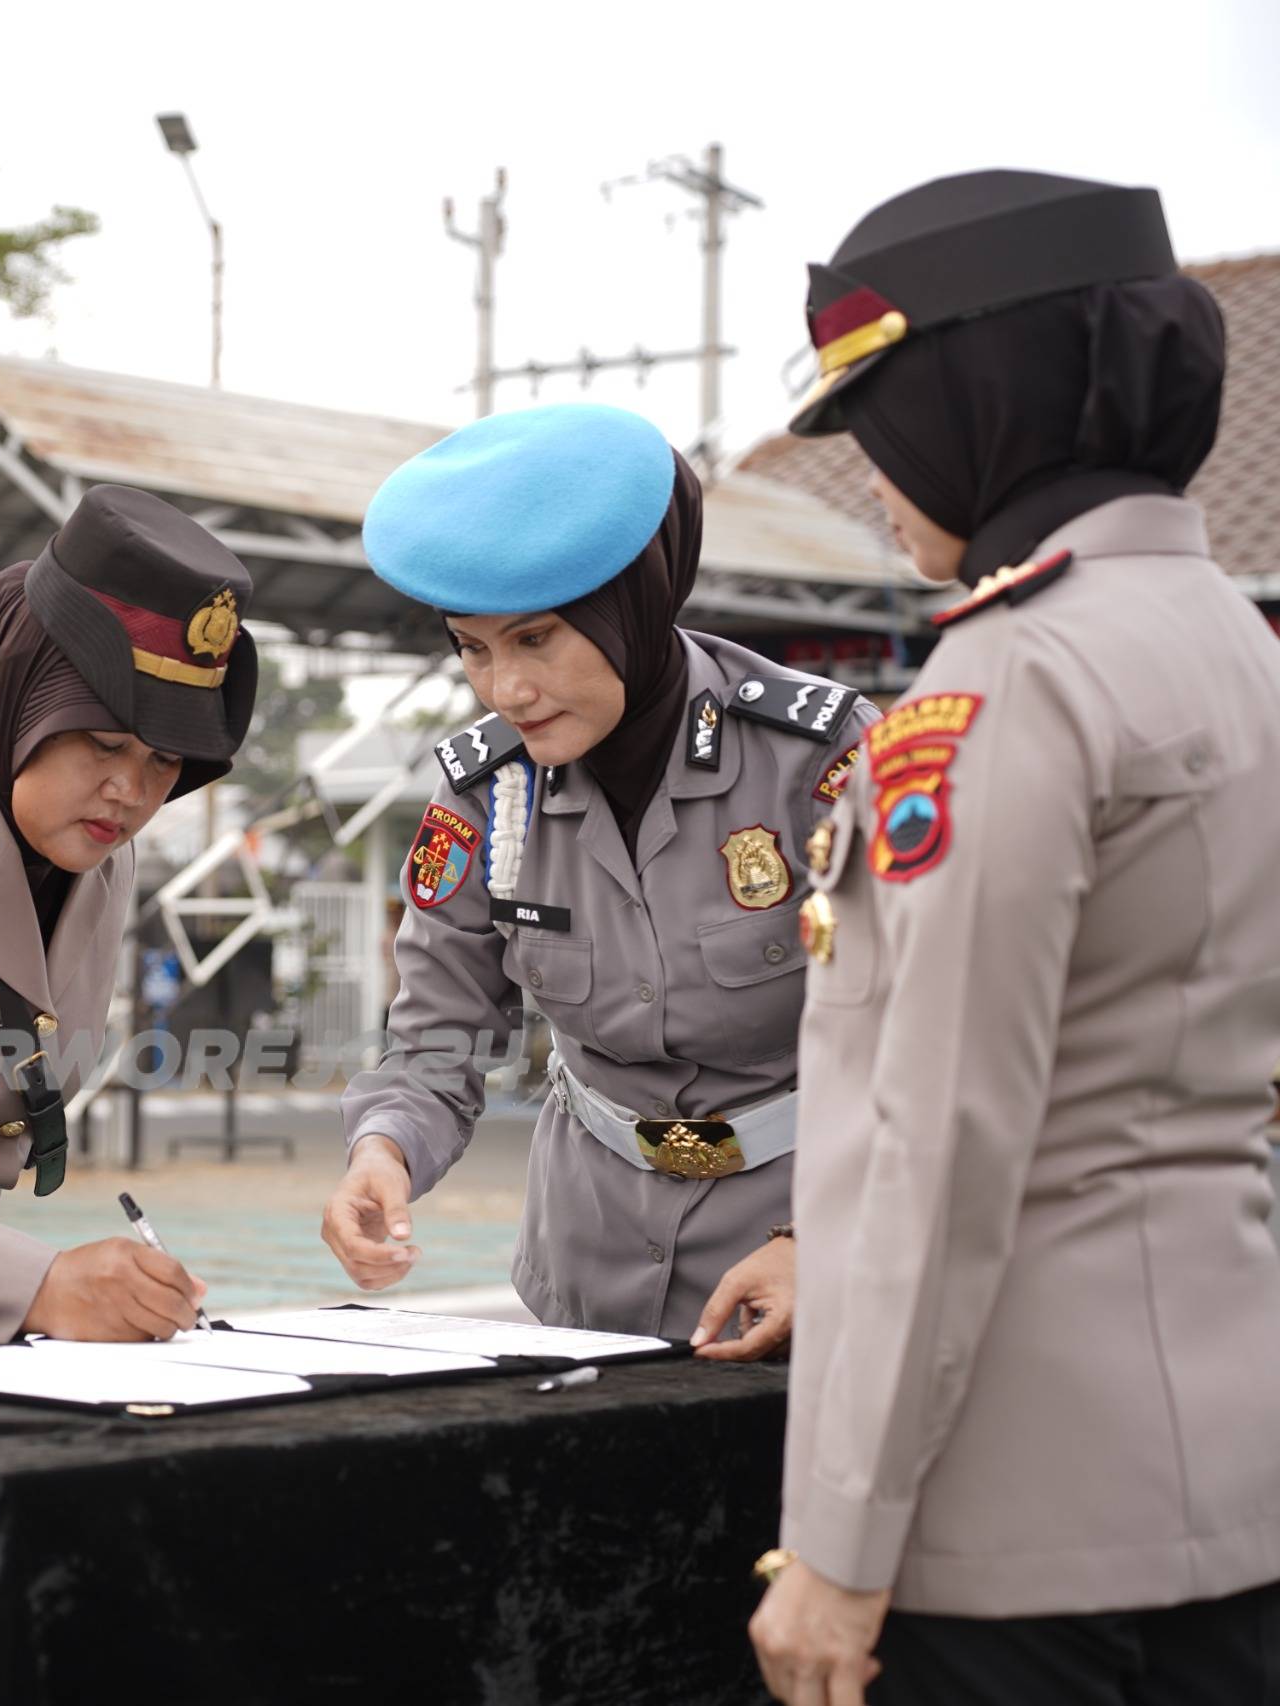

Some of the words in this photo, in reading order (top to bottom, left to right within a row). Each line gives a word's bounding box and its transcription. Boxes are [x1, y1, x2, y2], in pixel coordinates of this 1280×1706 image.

[811, 687, 846, 731] POLISI
[437, 738, 466, 781] POLISI
[432, 807, 472, 839] PROPAM
[516, 907, 540, 922] RIA
